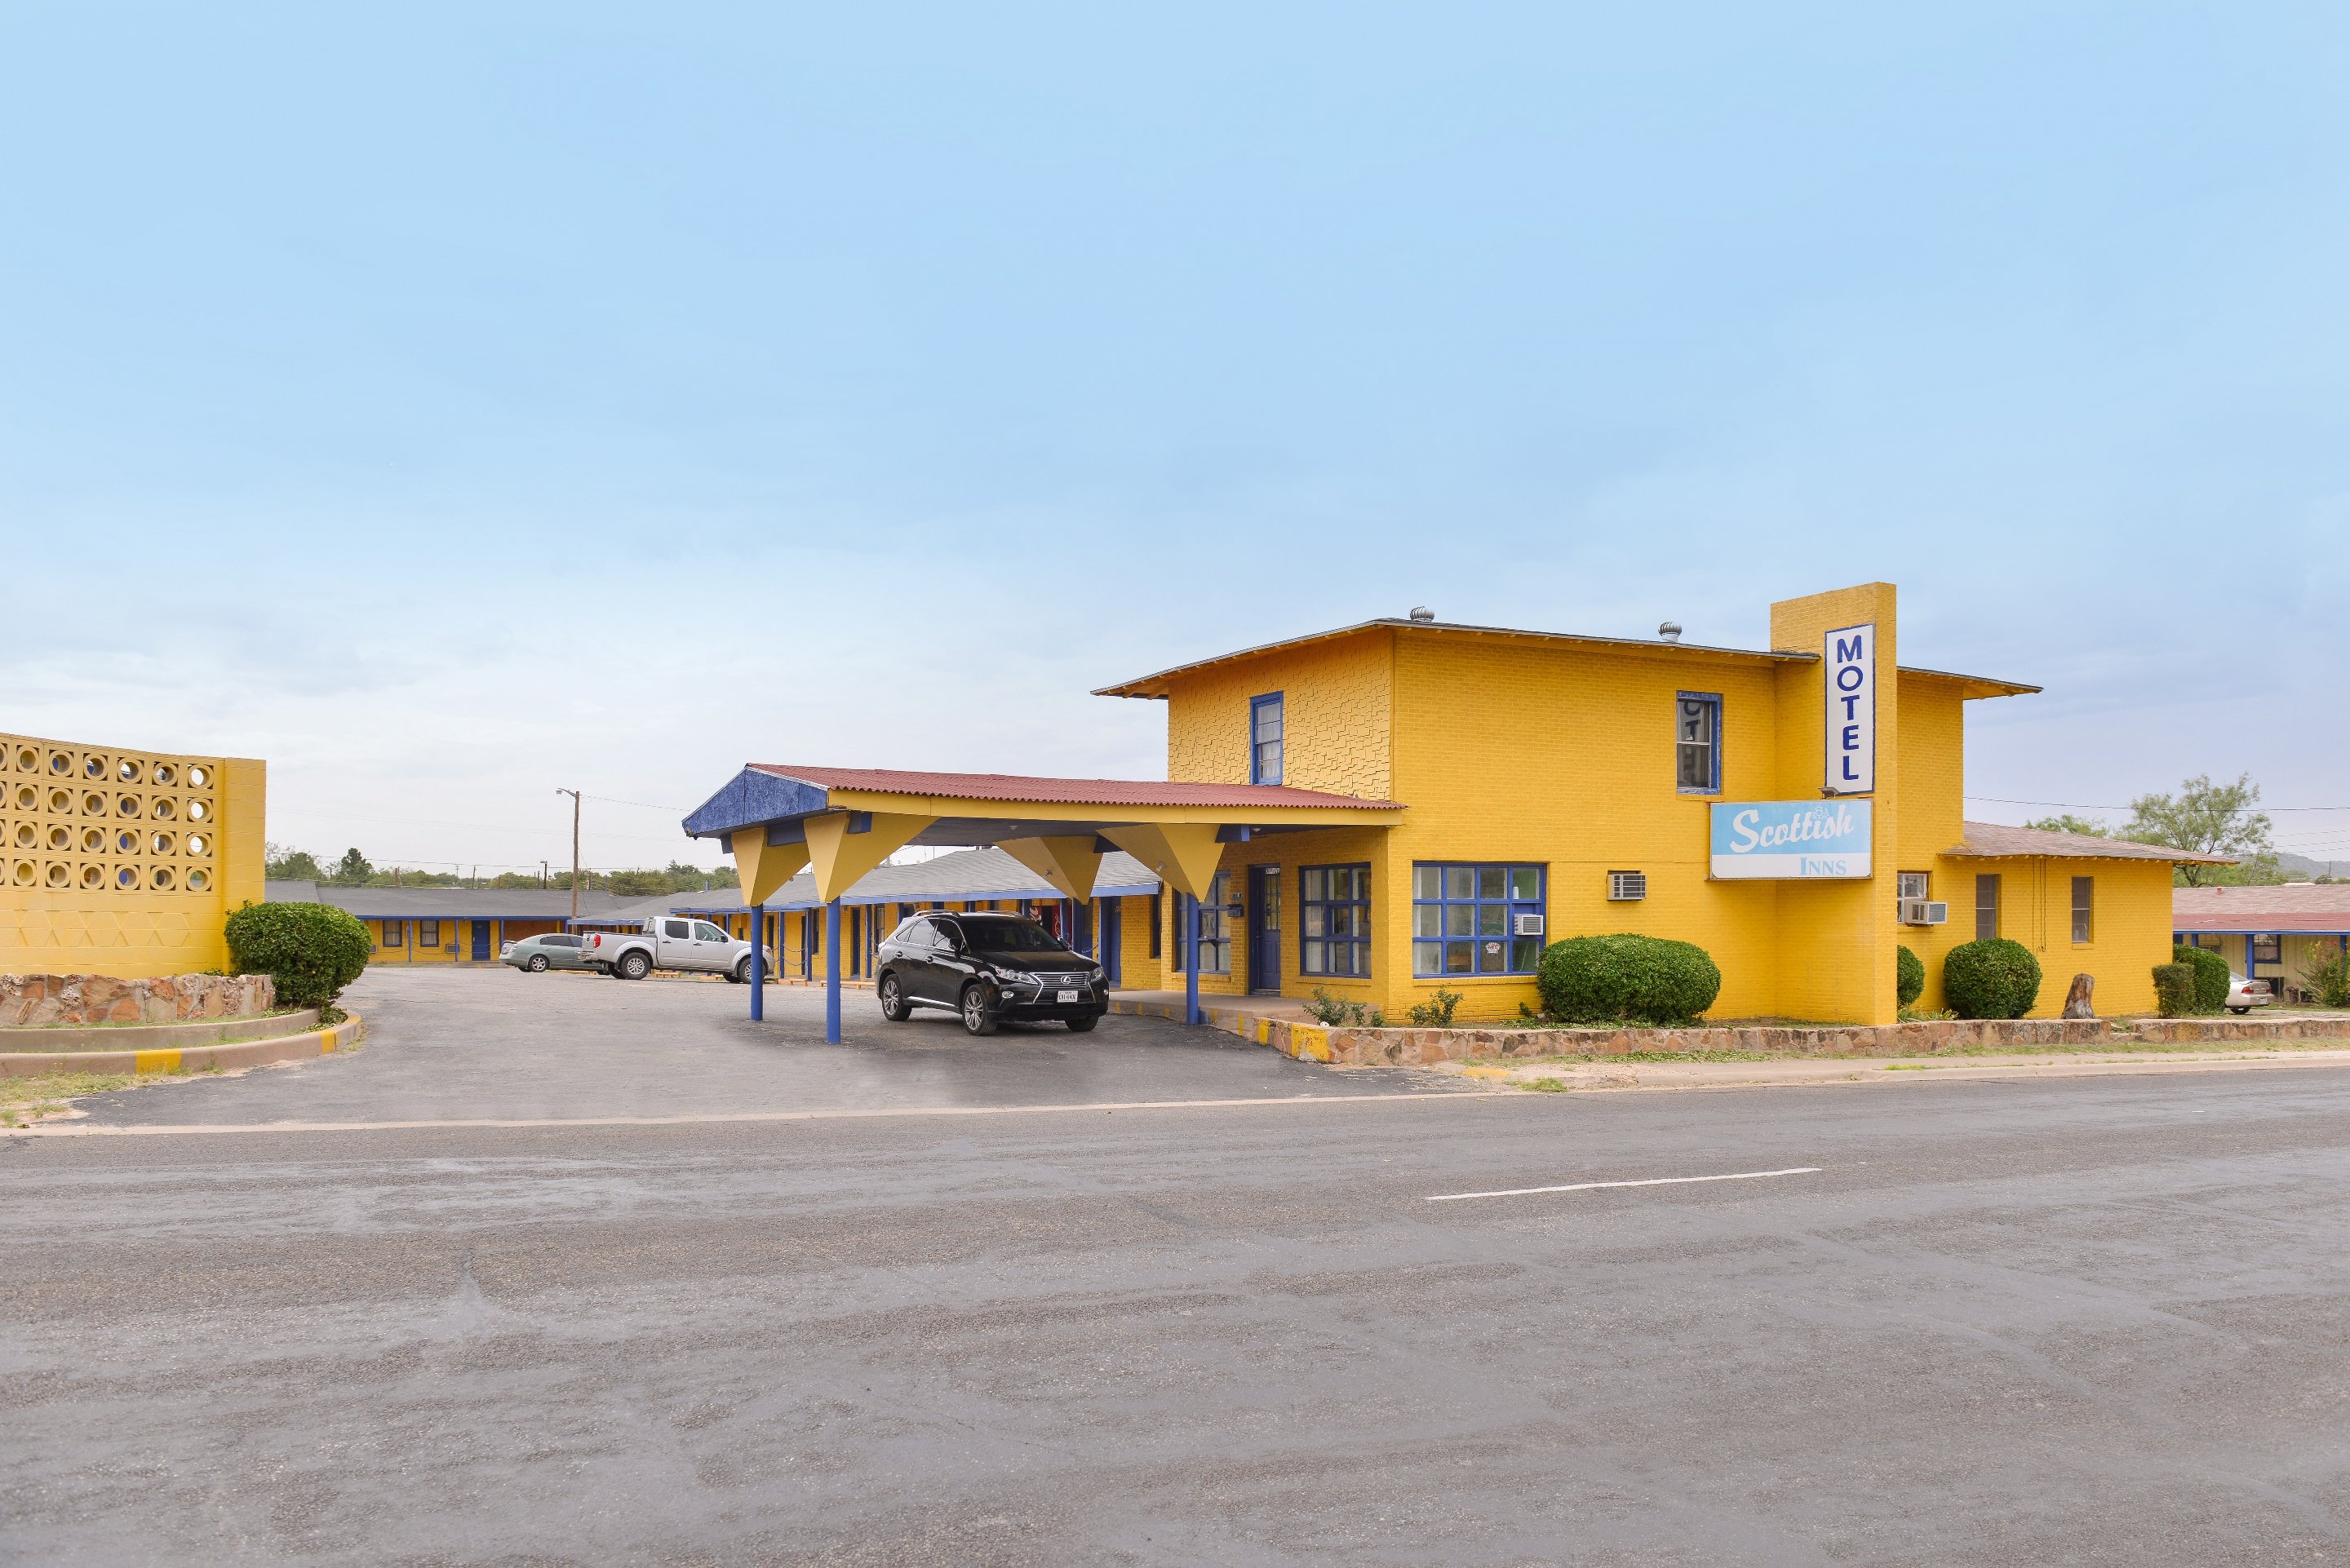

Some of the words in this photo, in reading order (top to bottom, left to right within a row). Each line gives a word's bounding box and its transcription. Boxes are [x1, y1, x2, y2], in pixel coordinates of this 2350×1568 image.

[1836, 634, 1864, 781] MOTEL
[1729, 804, 1855, 853] Scottish
[1799, 857, 1847, 875] INNS
